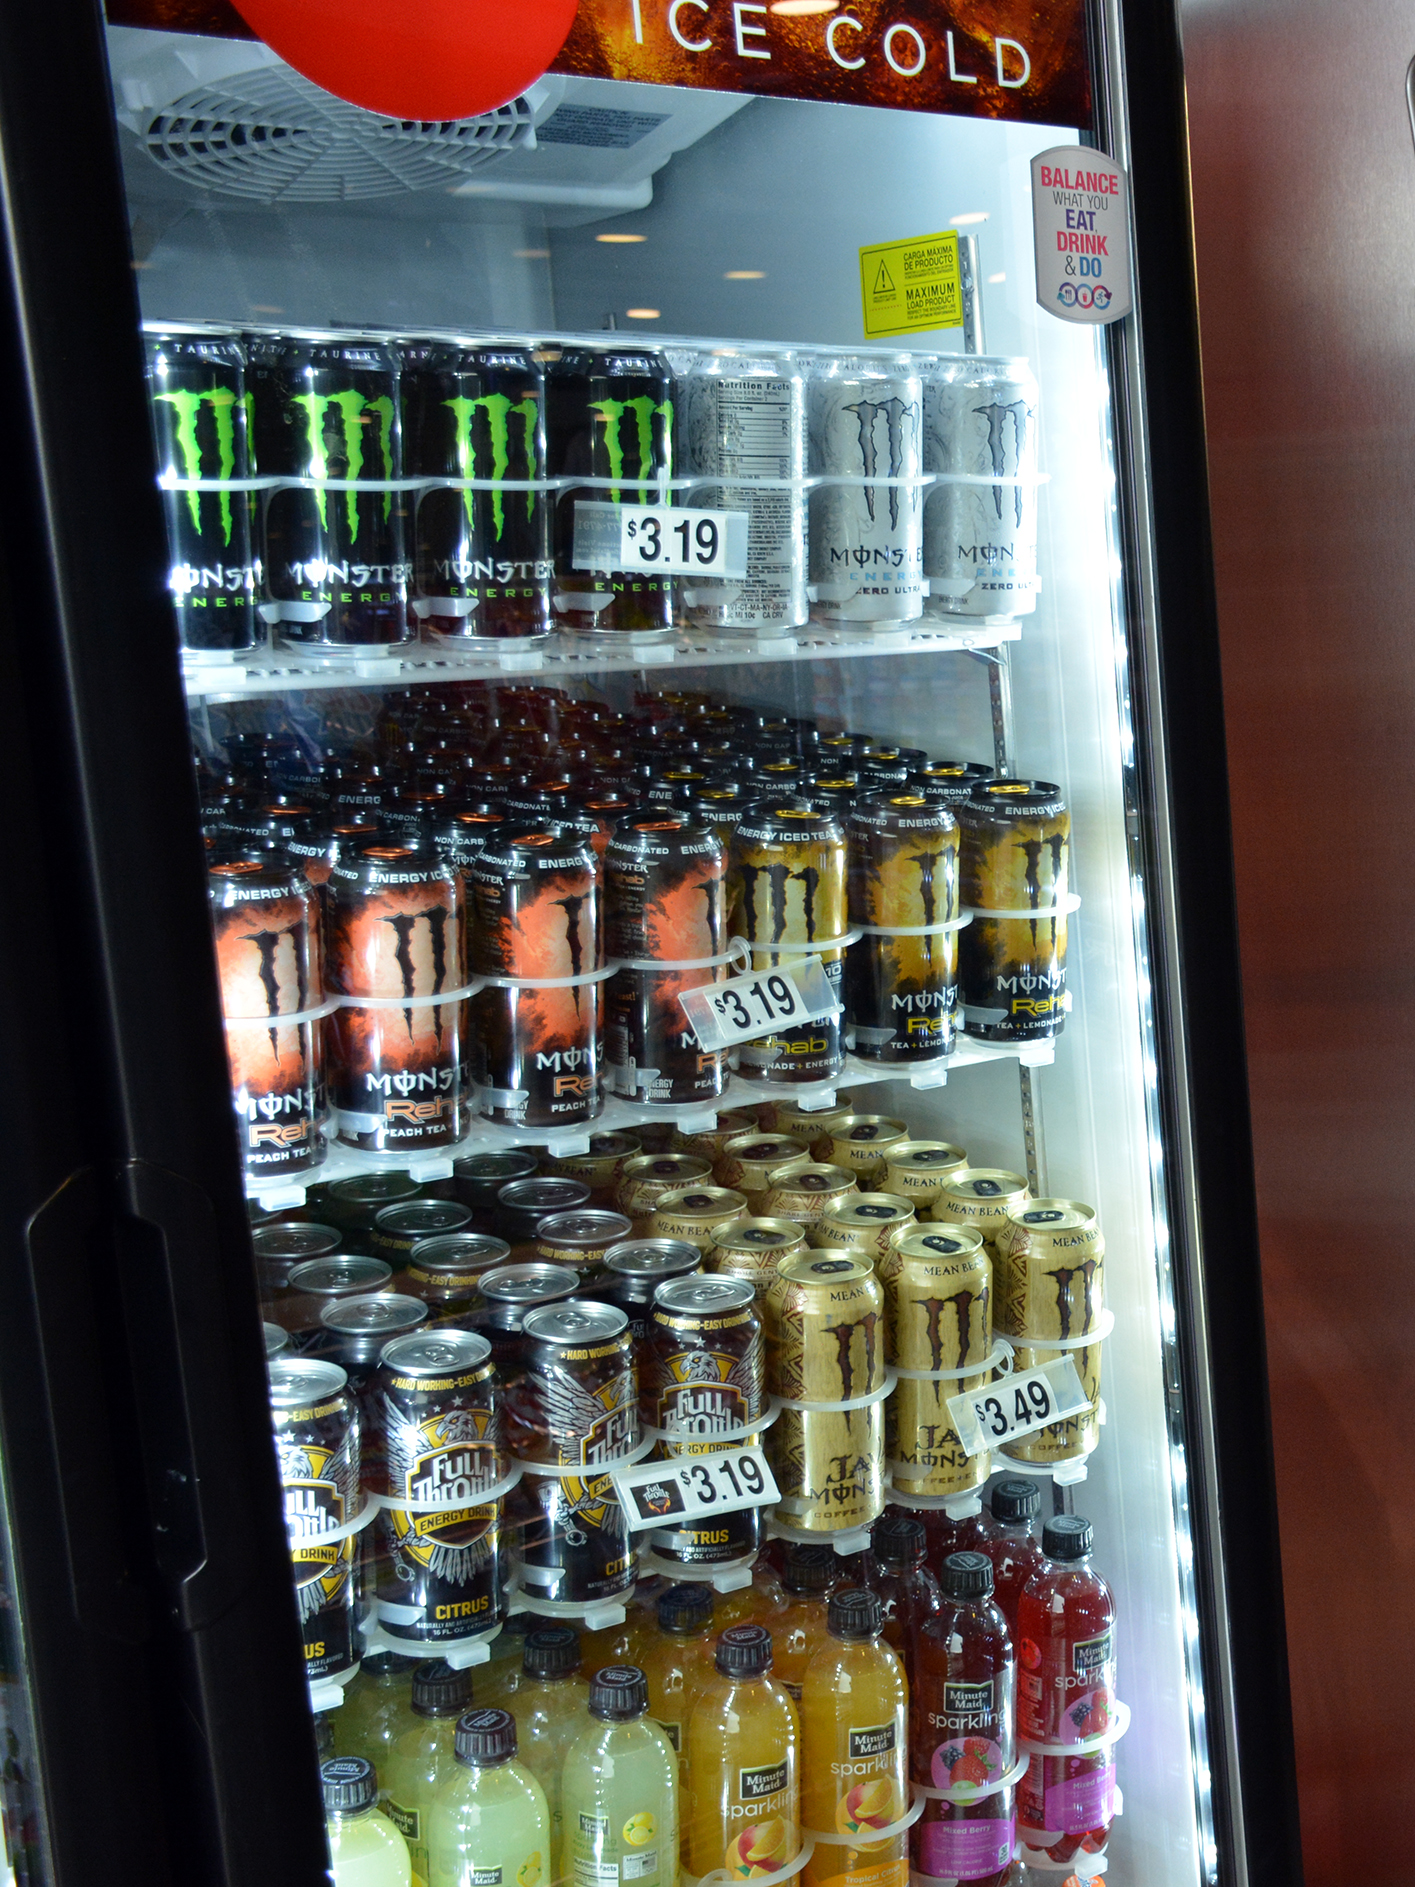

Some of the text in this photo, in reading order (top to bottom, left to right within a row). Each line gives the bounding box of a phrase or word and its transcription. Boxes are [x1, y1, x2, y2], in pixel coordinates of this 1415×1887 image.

[632, 0, 1031, 88] ICE COLD
[1040, 165, 1119, 195] BALANCE
[1052, 190, 1109, 211] WHAT YOU
[1056, 230, 1109, 256] DRINK
[903, 245, 953, 262] CARGA MÁXIMA
[904, 254, 954, 271] DE PRODUCTO
[1064, 255, 1102, 278] & DO
[906, 282, 955, 301] MAXIMUM
[906, 294, 955, 310] LOAD PRODUCT
[310, 349, 381, 361] TAURINE
[458, 353, 527, 365] TAURINE
[718, 381, 790, 391] Nutrition Facts
[627, 517, 719, 565] $3.19
[286, 555, 413, 588] MONSTER
[434, 557, 556, 583] MONSTER
[450, 587, 546, 598] ENERGY
[595, 581, 679, 592] ENERGY
[981, 582, 1013, 590] ZERO
[821, 757, 839, 765] NON
[1005, 806, 1050, 816] ENERGY
[575, 822, 600, 834] TEA
[898, 815, 943, 828] ENERGY
[435, 836, 453, 845] NON
[737, 826, 833, 842] ENERGY ICED TEA
[289, 841, 325, 857] ENERGY
[613, 840, 669, 855] CARBONATED
[539, 857, 585, 869] ENERGY
[369, 872, 427, 885] ENERGY
[229, 887, 289, 901] ENERGY
[714, 975, 796, 1029] $3.19
[997, 1021, 1013, 1029] TEA
[891, 1041, 909, 1049] TEA
[805, 1058, 838, 1069] ENERGY
[551, 1101, 586, 1113] PEACH
[383, 1124, 446, 1139] PEACH TEA
[791, 1123, 824, 1133] MEAN
[247, 1147, 312, 1163] PEACH TEA
[850, 1151, 883, 1160] MEAN
[903, 1177, 937, 1188] MEAN
[946, 1202, 1008, 1216] MEAN BEAN
[657, 1221, 684, 1234] MEAN
[1052, 1234, 1085, 1248] MEAN
[924, 1264, 960, 1277] MEAN
[829, 1288, 864, 1303] MEAN
[566, 1349, 588, 1361] HARD
[396, 1378, 415, 1391] HARD
[976, 1381, 1050, 1437] $3.49
[680, 1456, 765, 1504] $3.19
[420, 1505, 495, 1531] ENERGY DRINK
[300, 1548, 336, 1562] DRINK
[435, 1595, 489, 1620] CITRUS
[950, 1690, 988, 1702] Minute
[955, 1699, 983, 1709] Maid
[854, 1730, 893, 1745] Minute
[860, 1741, 888, 1754] Maid
[746, 1768, 785, 1786] Minute
[752, 1780, 781, 1795] Maid
[943, 1824, 991, 1834] Mixed Berry
[472, 1868, 500, 1880] Minute
